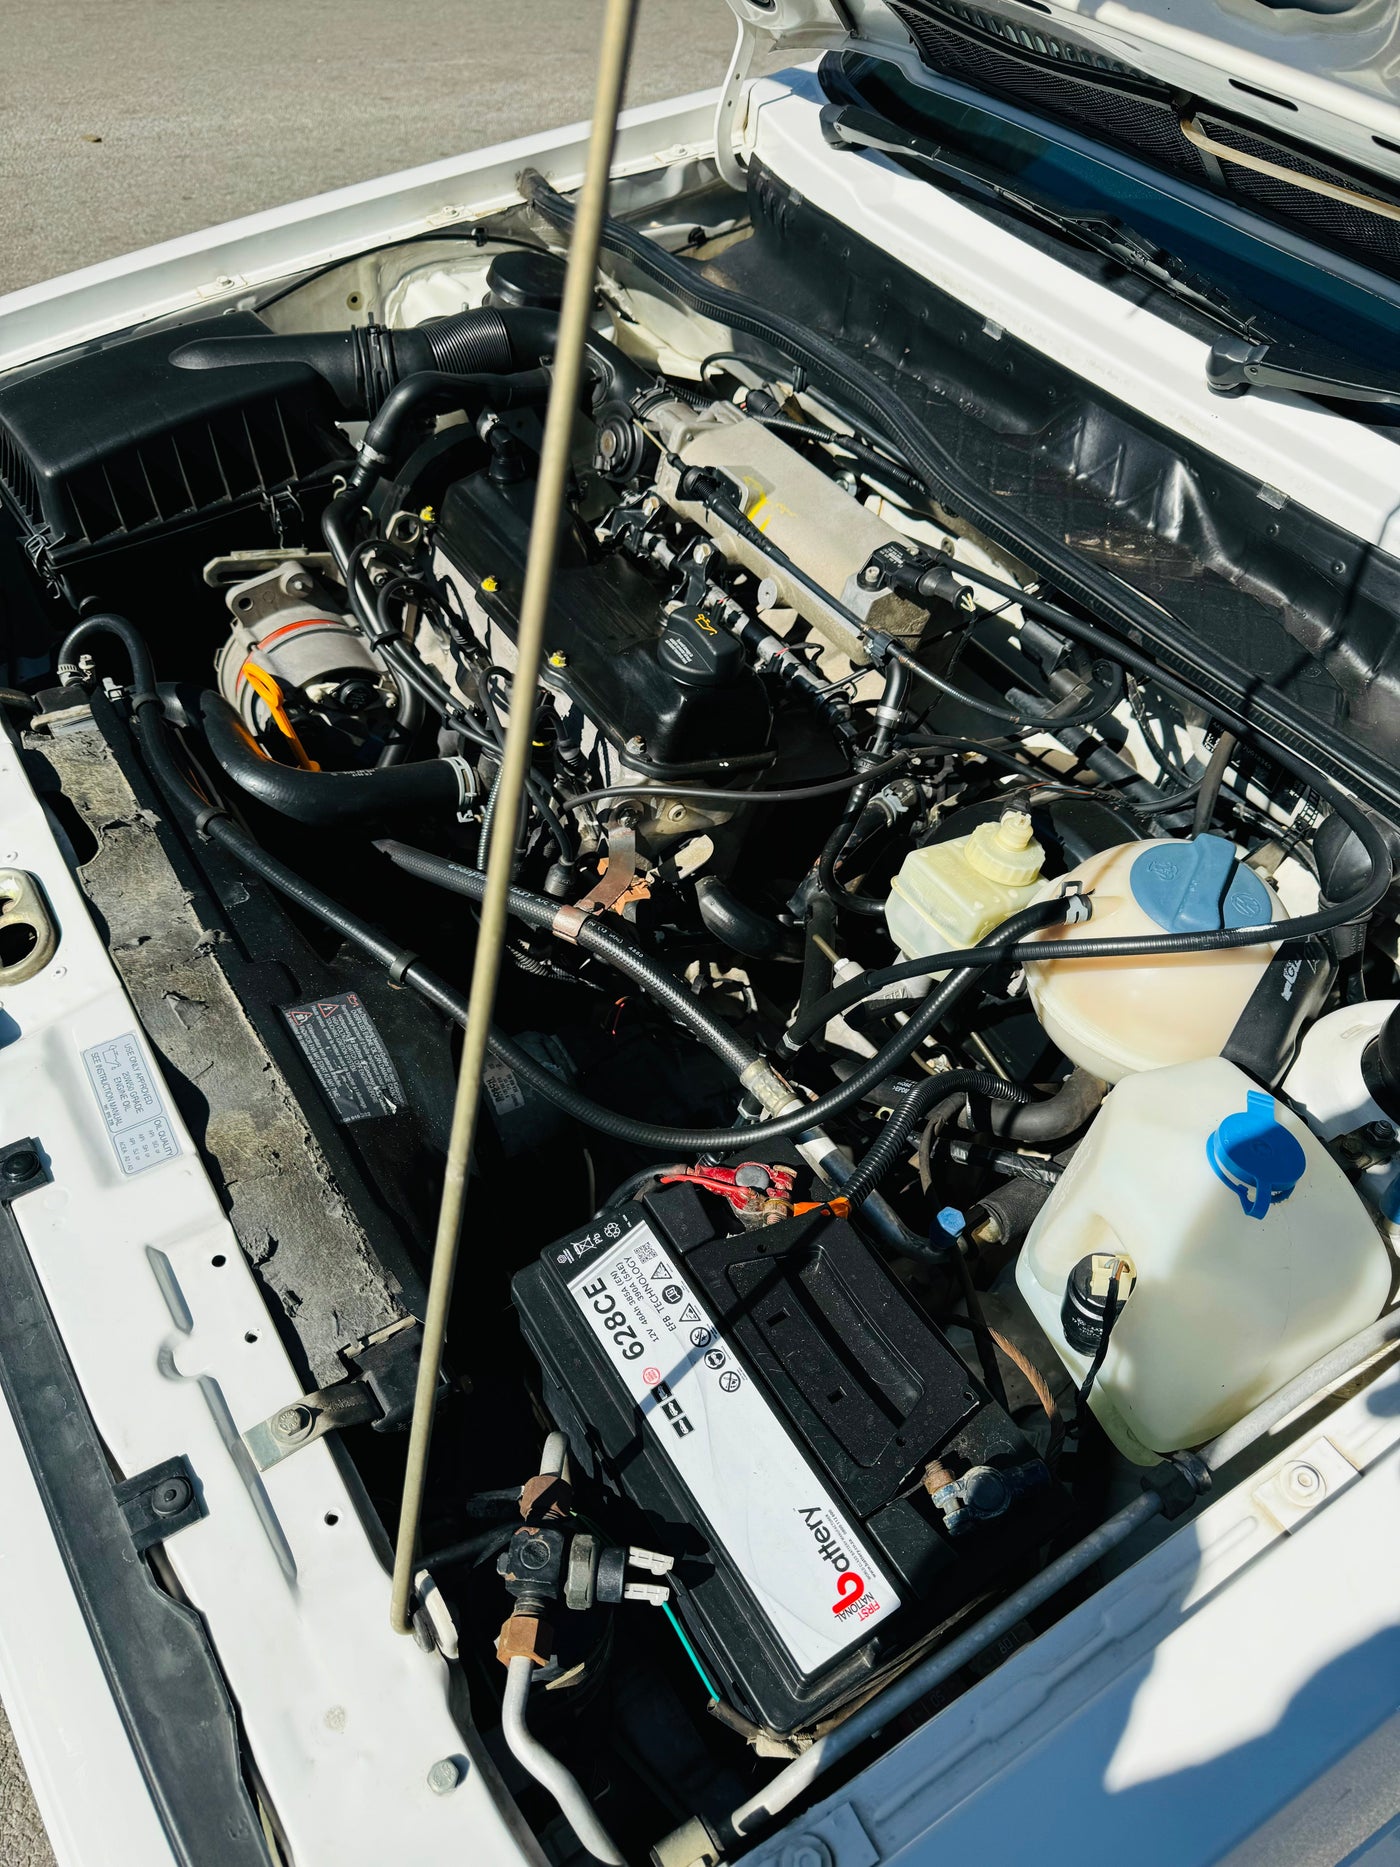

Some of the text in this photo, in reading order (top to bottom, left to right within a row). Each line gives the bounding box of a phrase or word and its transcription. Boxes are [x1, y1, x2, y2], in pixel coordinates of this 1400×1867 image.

[90, 1051, 101, 1064] SEE
[123, 1042, 153, 1105] USE ONLY APPROVED
[95, 1063, 114, 1102] INSTRUCTION
[113, 1076, 132, 1112] ENGINE OIL
[109, 1101, 122, 1126] MANUAL
[129, 1090, 144, 1114] GRADE
[153, 1119, 173, 1156] OIL QUALITY
[591, 1231, 603, 1244] Pb
[615, 1261, 644, 1301] 390A (SAE)
[623, 1256, 676, 1331] EFB TECHNOLOGY
[582, 1277, 644, 1359] 628CE
[609, 1270, 659, 1342] 12V 48Ah 385A (EN)
[800, 1507, 863, 1612] battery
[834, 1592, 874, 1621] NATIONAL
[857, 1600, 880, 1621] FIRST
